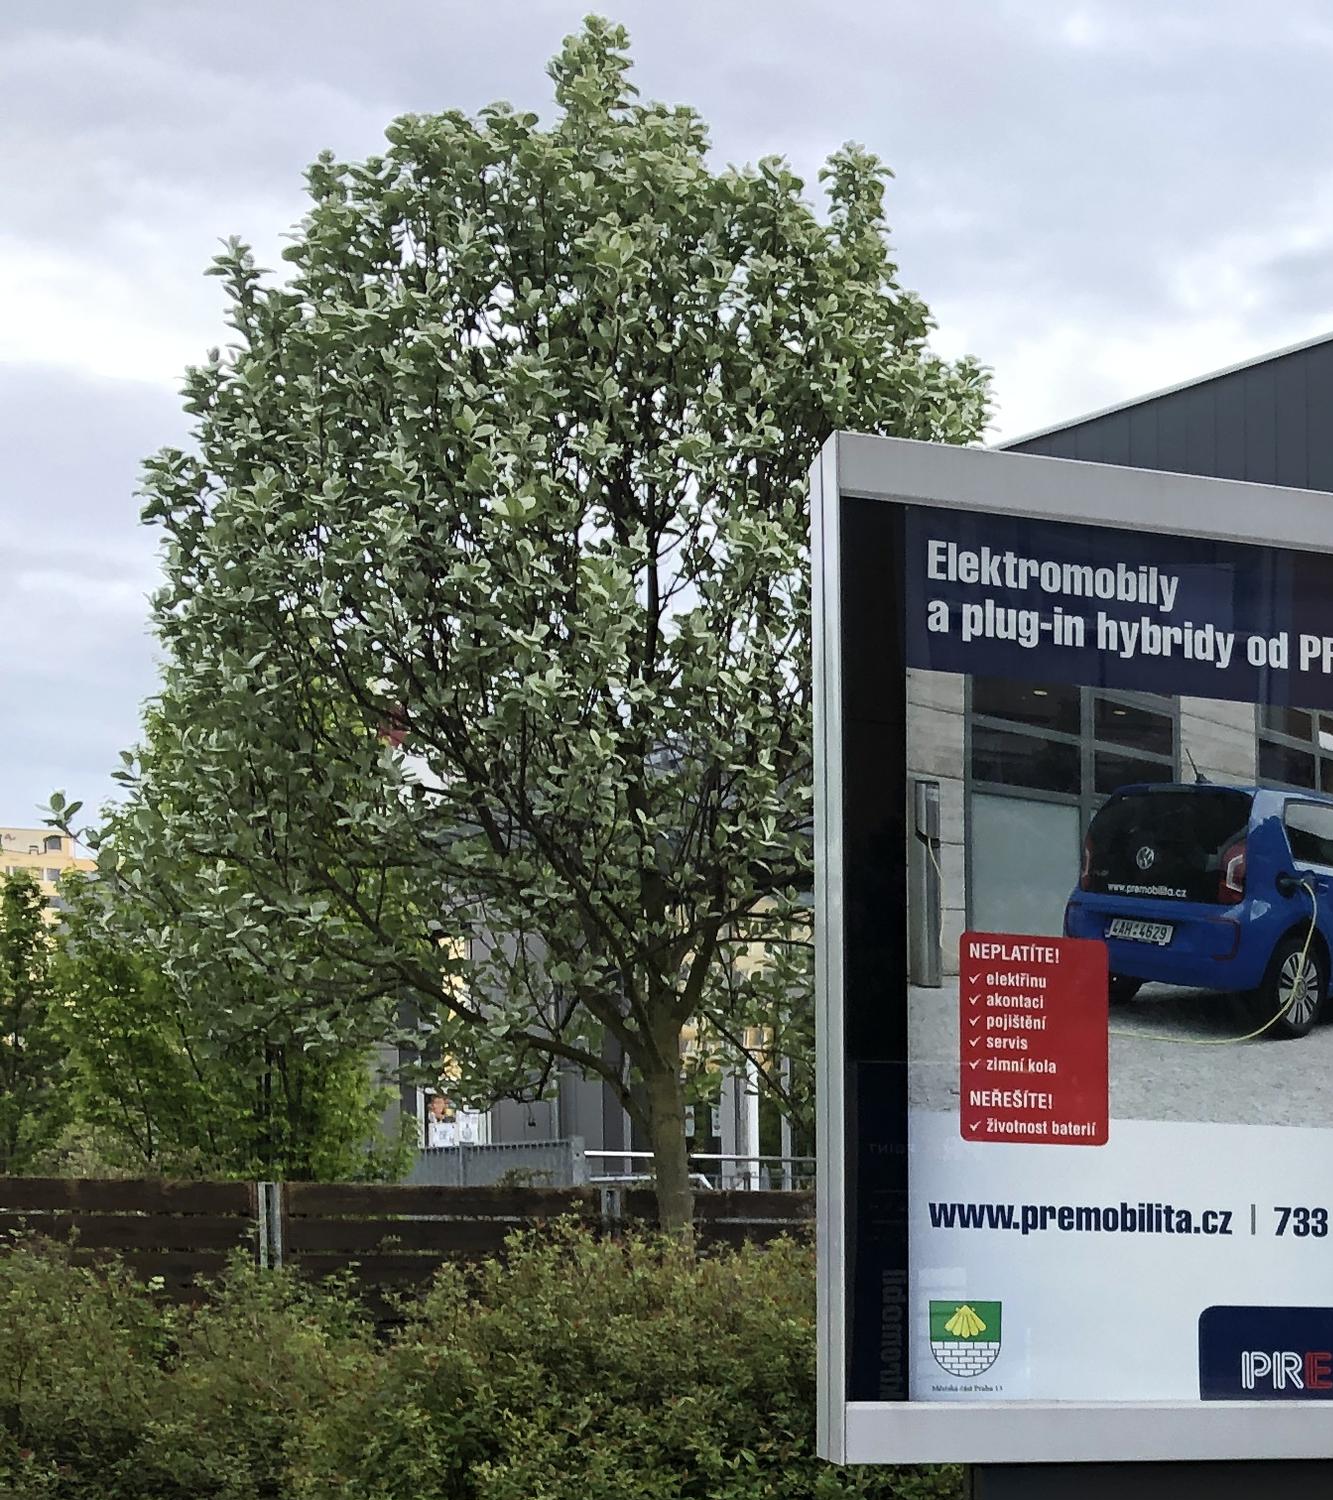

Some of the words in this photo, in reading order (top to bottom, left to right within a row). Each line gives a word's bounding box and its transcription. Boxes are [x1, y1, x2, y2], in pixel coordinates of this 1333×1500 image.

[927, 539, 1179, 613] Elektromobily
[927, 599, 950, 633] a
[961, 599, 1085, 649] plug-in
[1097, 611, 1235, 669] hybridy
[1247, 631, 1289, 670] od
[969, 942, 1060, 964] NEPLATÍTE!
[986, 972, 1047, 989] elektřinu
[986, 992, 1044, 1009] akontaci
[986, 1014, 1047, 1031] pojištění
[986, 1035, 1028, 1050] servis
[986, 1056, 1024, 1072] zimní
[1028, 1058, 1057, 1074] kola
[969, 1088, 1053, 1110] NEŘEŠÍTE!
[986, 1117, 1048, 1135] životnost
[1052, 1120, 1096, 1137] baterií
[929, 1202, 1233, 1235] www.premobilita.cz
[1273, 1206, 1328, 1238] 733
[1241, 1351, 1333, 1390] PRE
